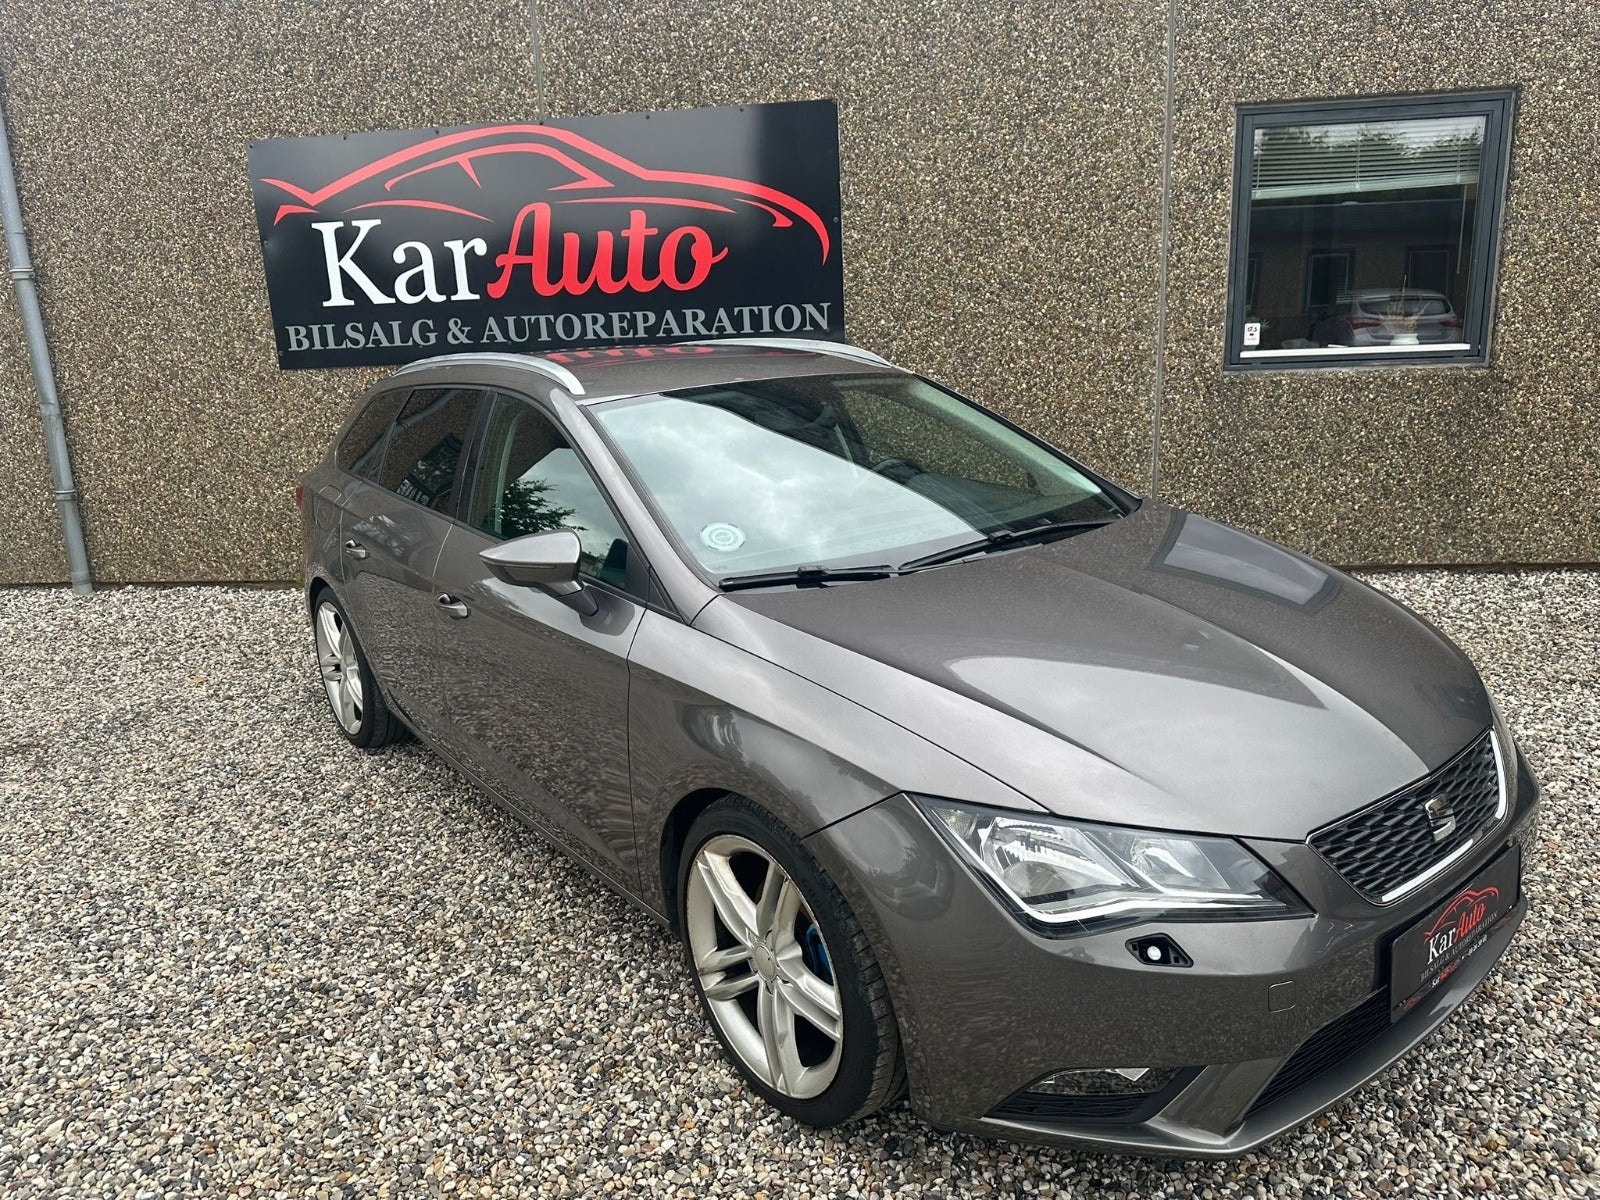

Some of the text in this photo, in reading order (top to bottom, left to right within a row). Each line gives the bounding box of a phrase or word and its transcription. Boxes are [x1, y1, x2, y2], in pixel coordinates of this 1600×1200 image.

[311, 202, 729, 307] KarAuto
[285, 302, 831, 350] BILSALG & AUTOREPARATION
